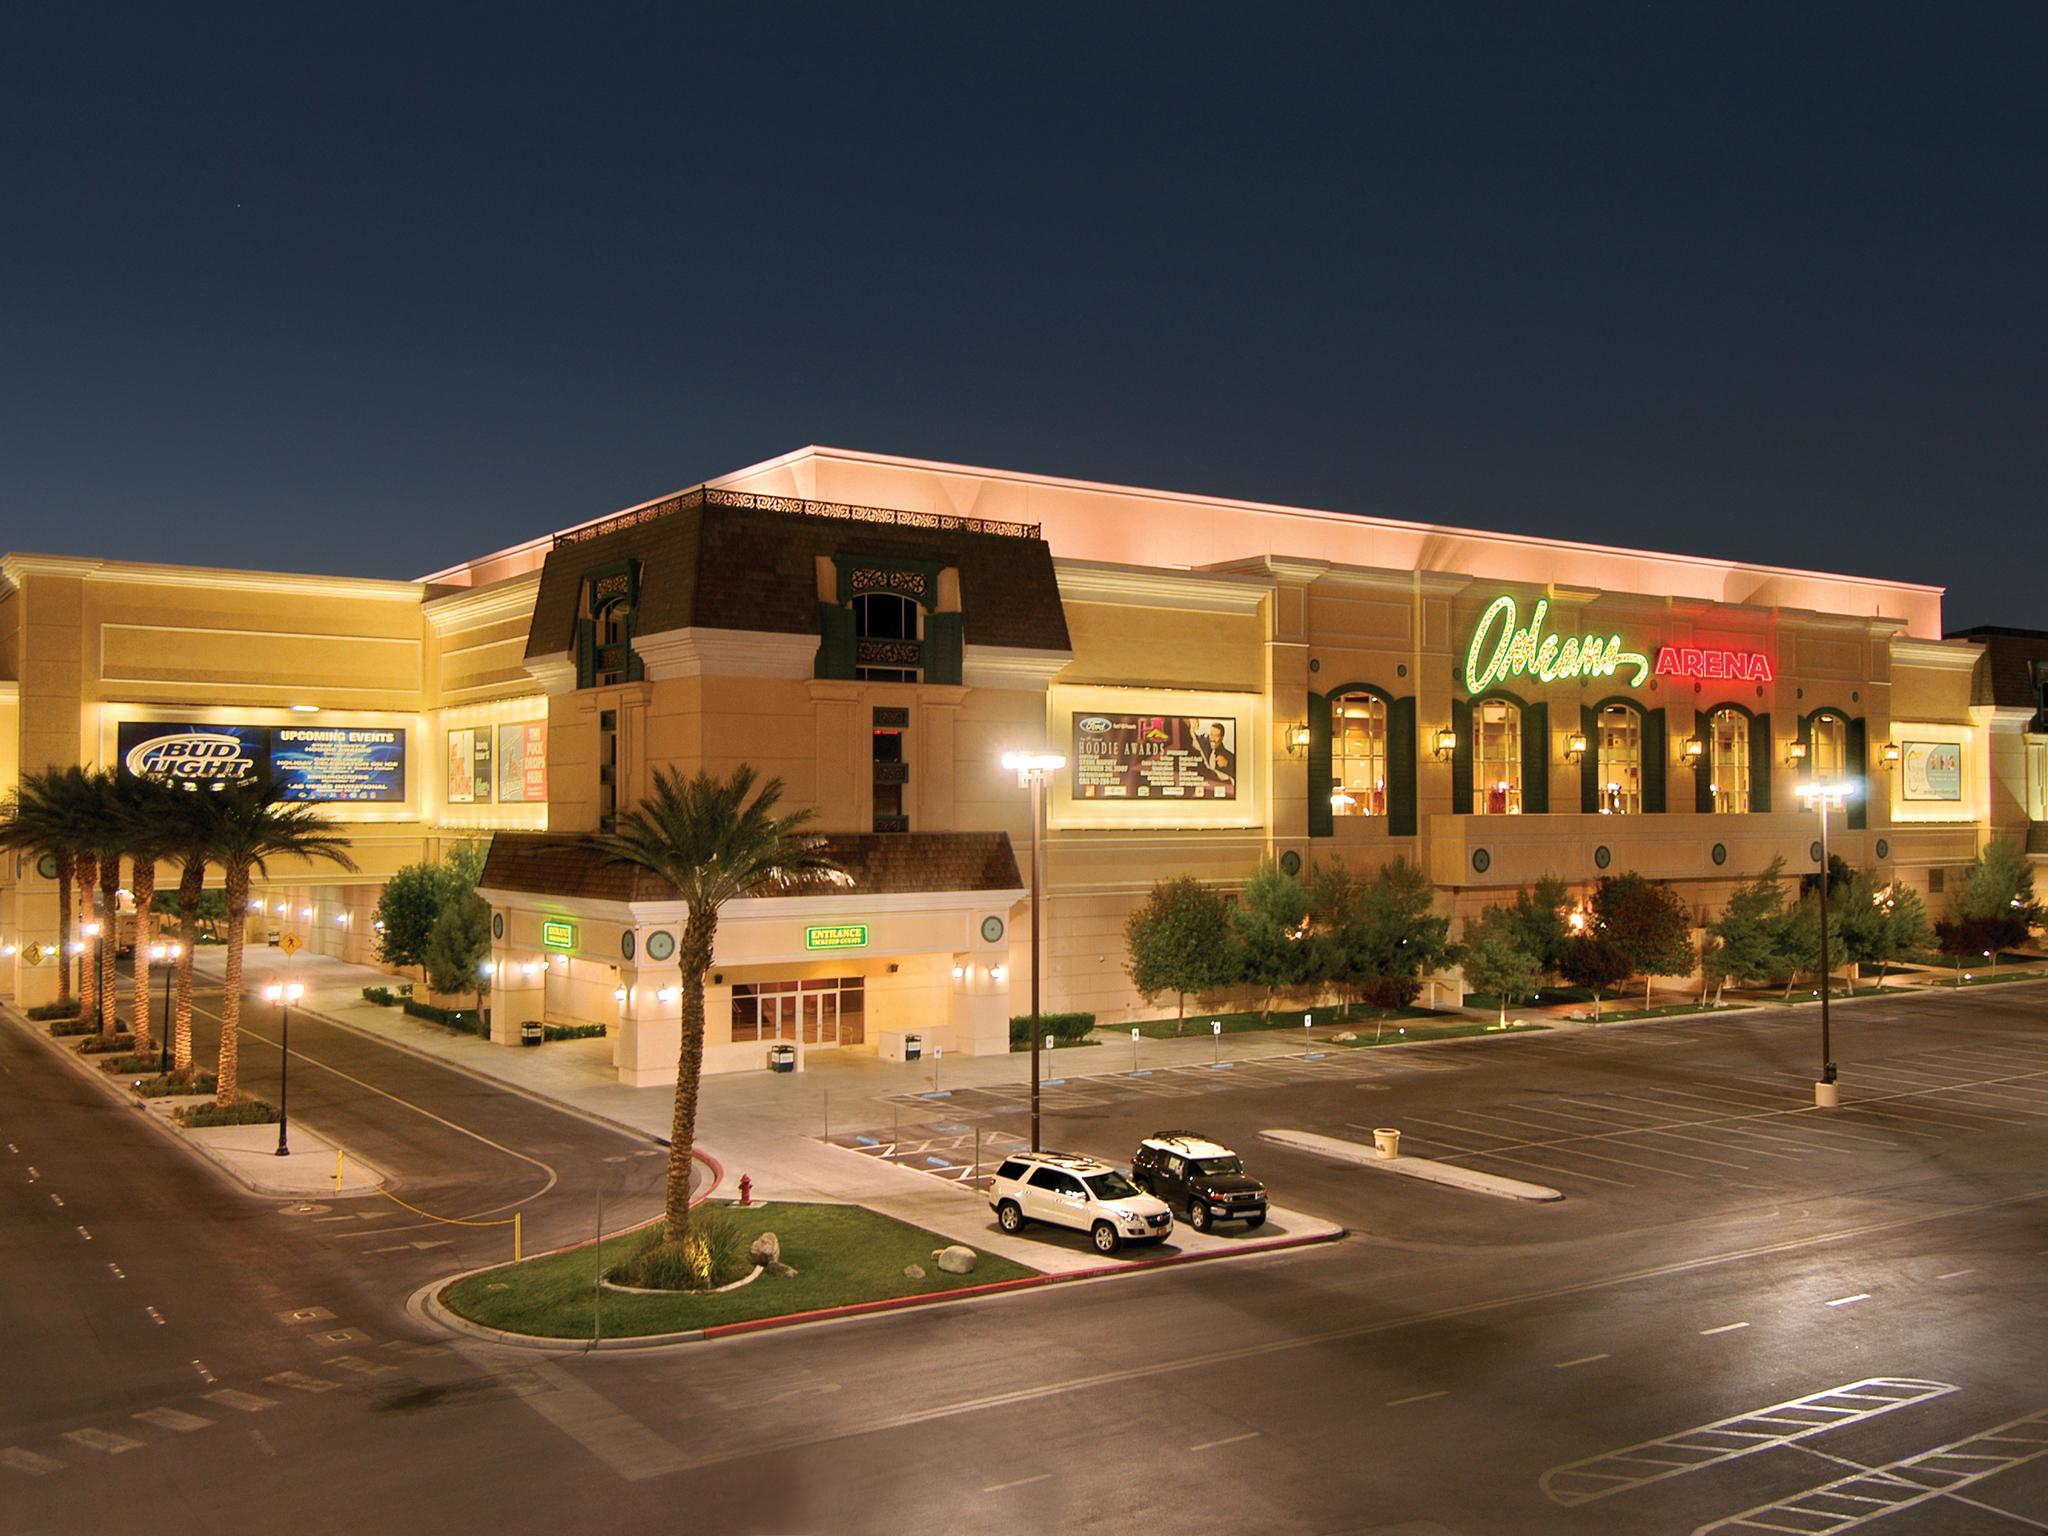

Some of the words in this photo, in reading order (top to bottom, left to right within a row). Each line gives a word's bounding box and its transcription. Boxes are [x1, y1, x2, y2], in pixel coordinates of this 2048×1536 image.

[1466, 595, 1649, 694] Orleans
[1655, 647, 1773, 681] ARENA
[280, 730, 346, 742] UPCOMING
[349, 732, 395, 743] EVENTS
[529, 727, 541, 740] THE
[162, 743, 238, 757] BUD
[527, 741, 543, 755] PUCK
[1079, 742, 1119, 755] HOODIE
[1124, 743, 1165, 756] AWARDS
[145, 760, 249, 775] LIGHT
[525, 756, 546, 770] DROPS
[527, 770, 543, 784] HERE
[811, 928, 862, 939] ENTRANCE
